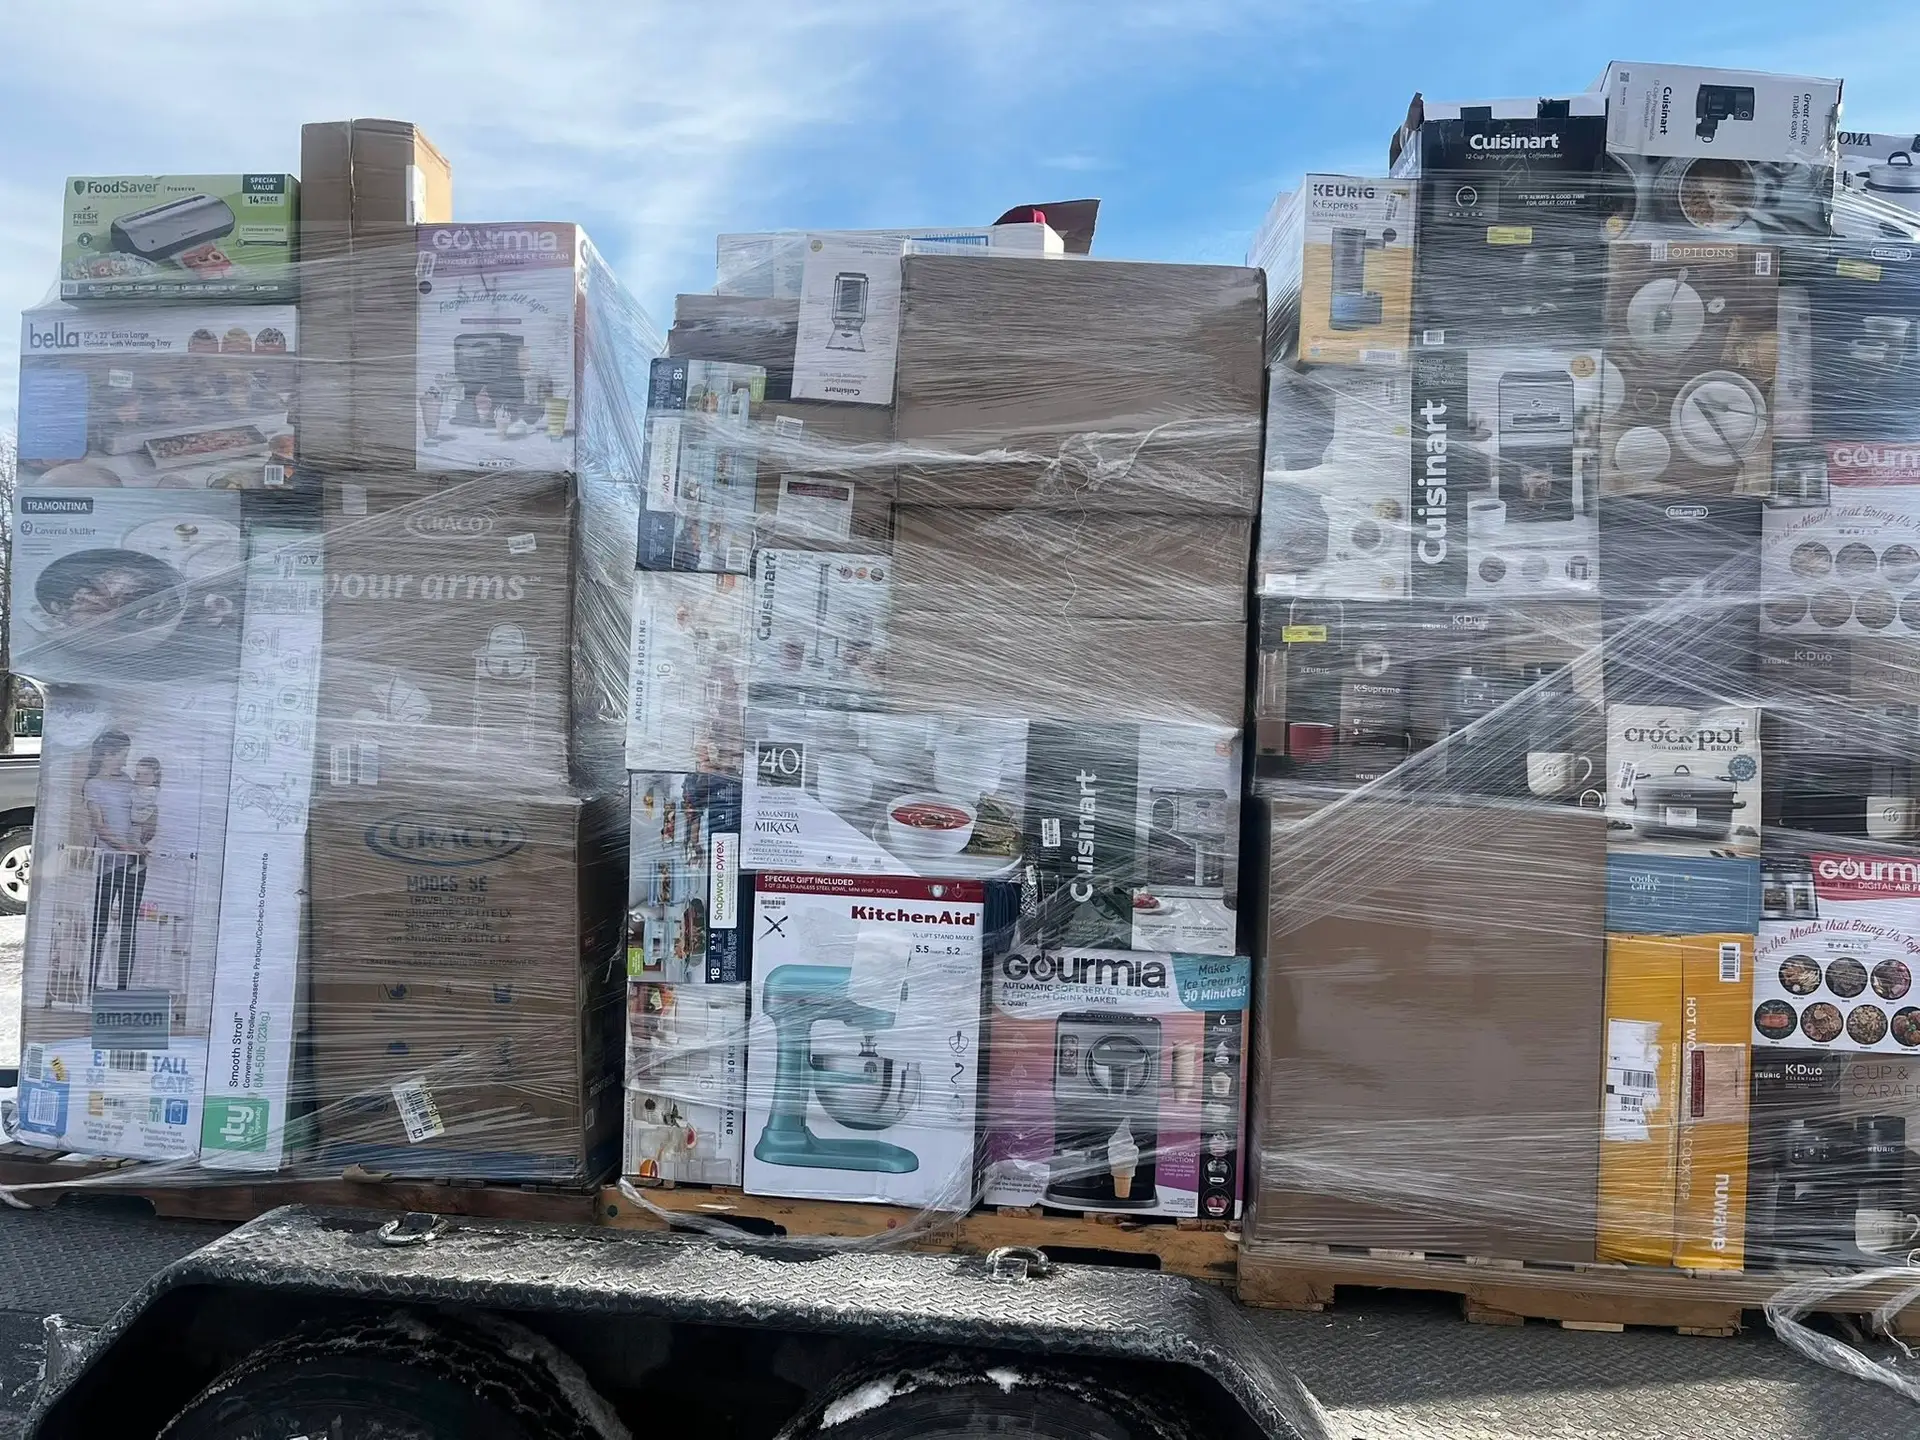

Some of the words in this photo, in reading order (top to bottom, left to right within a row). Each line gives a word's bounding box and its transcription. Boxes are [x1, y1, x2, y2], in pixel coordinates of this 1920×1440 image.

[1658, 86, 1672, 135] Cuisinart
[1792, 95, 1801, 119] made
[1802, 93, 1812, 117] Great
[1789, 120, 1799, 142] easy.
[1801, 119, 1811, 145] coffee
[1470, 132, 1560, 151] Cuisinart
[1486, 152, 1526, 161] Programmable
[1528, 152, 1563, 161] Coffeemaker
[87, 180, 159, 195] FoodSaver
[250, 177, 278, 185] SPECIAL
[252, 184, 275, 192] VALUE
[248, 196, 260, 205] 14
[260, 195, 278, 203] PIECE
[1313, 184, 1375, 199] KEURIG
[432, 227, 557, 251] Gourmia
[1671, 246, 1735, 258] OPTIONS
[29, 321, 80, 350] bella
[110, 340, 123, 348] with
[124, 339, 154, 350] Warming
[155, 339, 172, 350] Tray
[111, 331, 128, 339] Extra
[130, 331, 149, 341] Large
[673, 367, 683, 380] 18
[824, 386, 861, 397] Cuisinart
[1417, 398, 1447, 565] Cuisinart
[27, 500, 88, 512] TRAMONTINA
[416, 511, 485, 532] GRACO
[1862, 505, 1895, 526] Bring
[34, 526, 67, 536] Covered
[69, 526, 96, 536] Skillet
[757, 551, 778, 642] Cuisinart
[637, 619, 647, 666] HOCKING
[656, 662, 673, 679] 16
[1300, 667, 1331, 675] KEURIG
[634, 679, 646, 722] ANCHOR
[1668, 742, 1693, 751] cooker
[759, 747, 800, 775] 40
[757, 810, 800, 819] SAMANTHA
[390, 821, 511, 850] GRACO
[753, 820, 801, 836] MIKASA
[1069, 768, 1098, 903] Cuisinart
[714, 840, 727, 871] pyrex
[258, 852, 269, 899] Conveniente
[764, 874, 795, 884] SPECIAL
[796, 876, 815, 885] GIFT
[815, 877, 854, 887] INCLUDED
[1629, 874, 1653, 884] cook
[1858, 881, 1893, 891] DIGITAL
[1894, 883, 1911, 891] AIR
[447, 896, 486, 906] SYSTEM
[713, 872, 726, 921] Snapware
[851, 905, 976, 927] KitchenAid
[1790, 922, 1823, 941] Meals
[1825, 919, 1851, 931] that
[1851, 919, 1885, 940] Bring
[915, 944, 930, 953] 5.5
[946, 946, 961, 955] 5.2
[710, 967, 720, 981] 18
[1002, 952, 1169, 988] Gourmia
[1198, 963, 1232, 977] Makes
[1002, 981, 1054, 992] AUTOMATIC
[1054, 984, 1080, 994] SOFT
[1082, 986, 1115, 995] SERVE
[1116, 987, 1133, 996] ICE
[1134, 988, 1170, 998] CREAM
[1183, 978, 1198, 990] Ice
[1199, 975, 1234, 988] Cream
[1010, 991, 1051, 1000] FROZEN
[1053, 993, 1083, 1002] DRINK
[1085, 995, 1118, 1005] MAKER
[1183, 989, 1198, 1003] 30
[1199, 986, 1247, 1001] Minutes!
[245, 971, 261, 1040] Stroller/Poussette
[1007, 1000, 1028, 1008] Quart
[1686, 996, 1697, 1025] HOT
[96, 1008, 163, 1027] amazon
[1219, 1015, 1227, 1026] 6
[257, 1011, 270, 1044] (23kg)
[1670, 1043, 1678, 1063] CREATE
[151, 1055, 190, 1076] TALL
[229, 1047, 242, 1088] Smooth
[243, 1040, 255, 1089] Convenience
[1852, 1065, 1892, 1080] CUP
[1896, 1065, 1909, 1080] &
[1755, 1071, 1781, 1079] KEURIG
[219, 1105, 254, 1143] ity
[1160, 1155, 1195, 1164] FUNCTION
[1680, 1138, 1693, 1200] COOKTOP
[1711, 1173, 1731, 1251] nuwave
